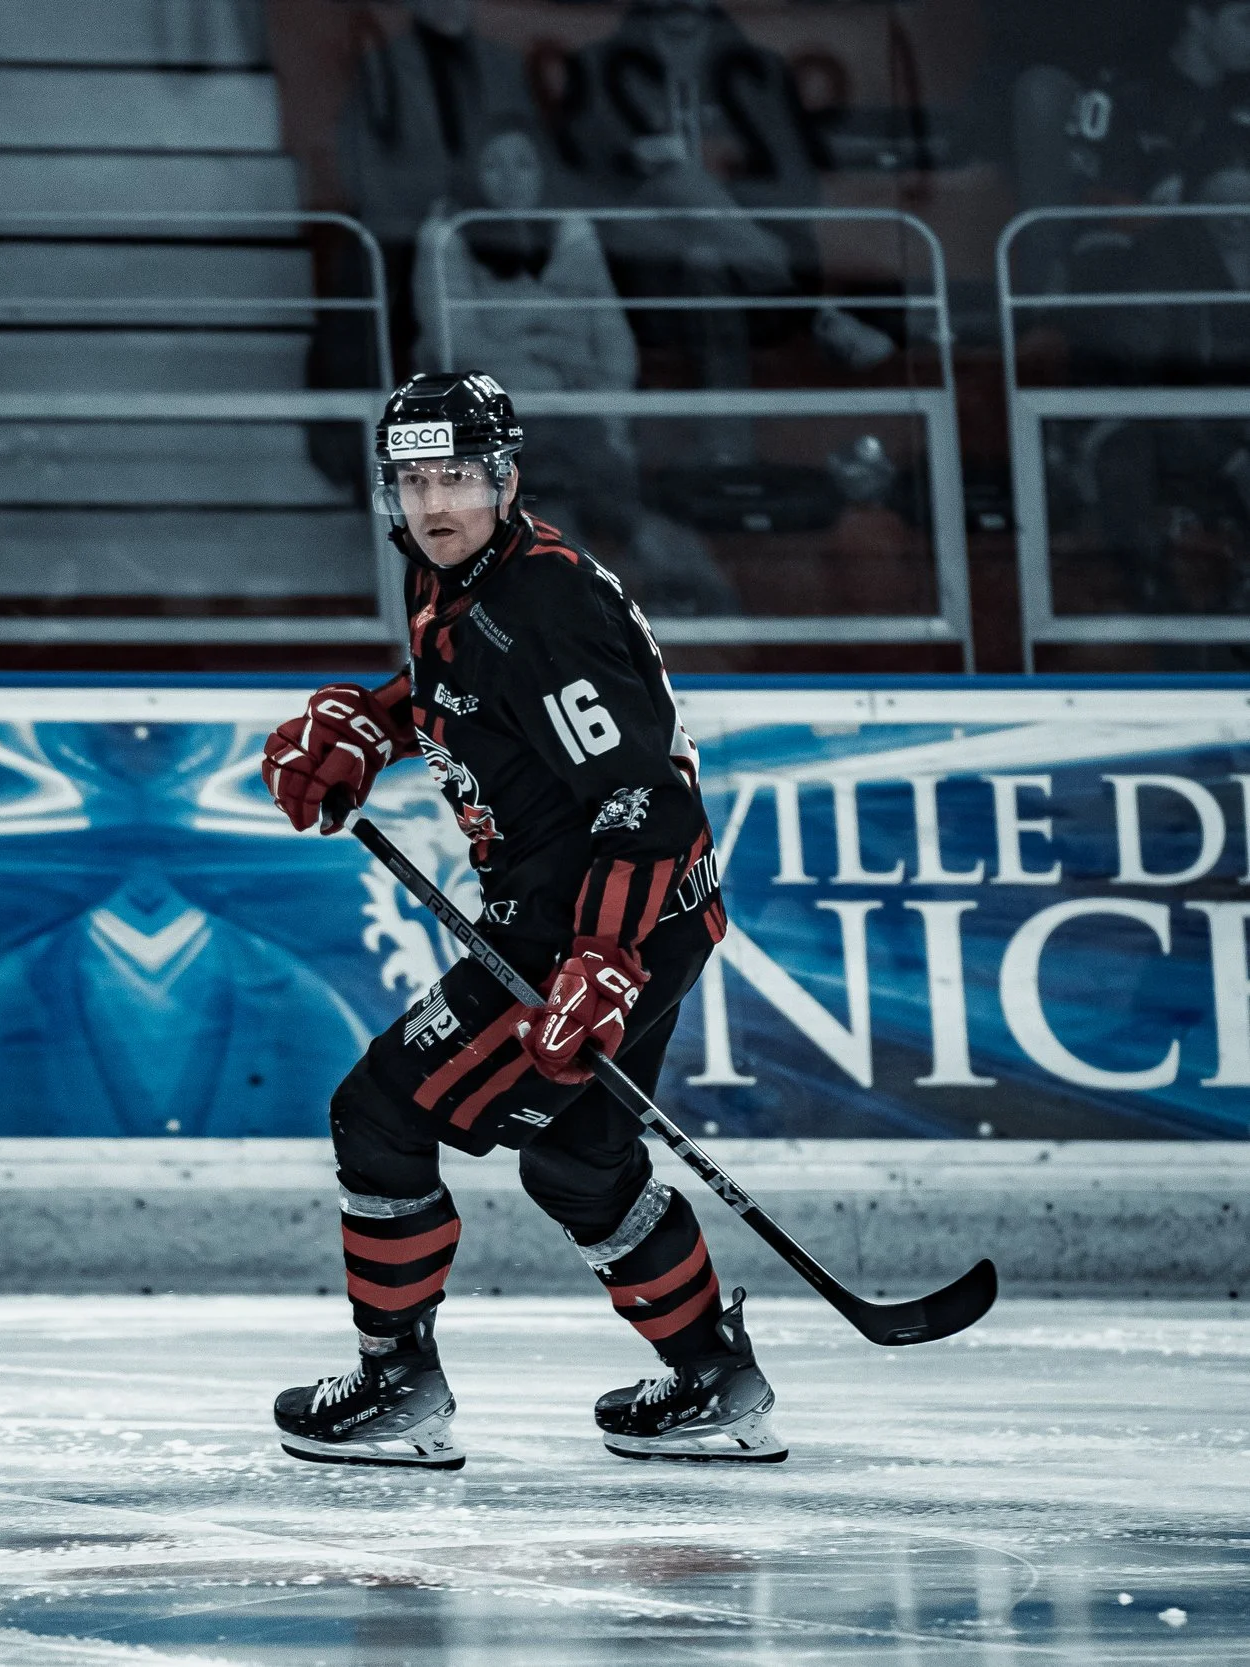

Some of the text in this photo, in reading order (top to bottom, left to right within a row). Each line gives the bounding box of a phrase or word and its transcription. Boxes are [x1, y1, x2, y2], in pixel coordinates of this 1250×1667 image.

[543, 678, 621, 765] 16
[1101, 774, 1250, 887] D
[596, 967, 639, 1009] CC
